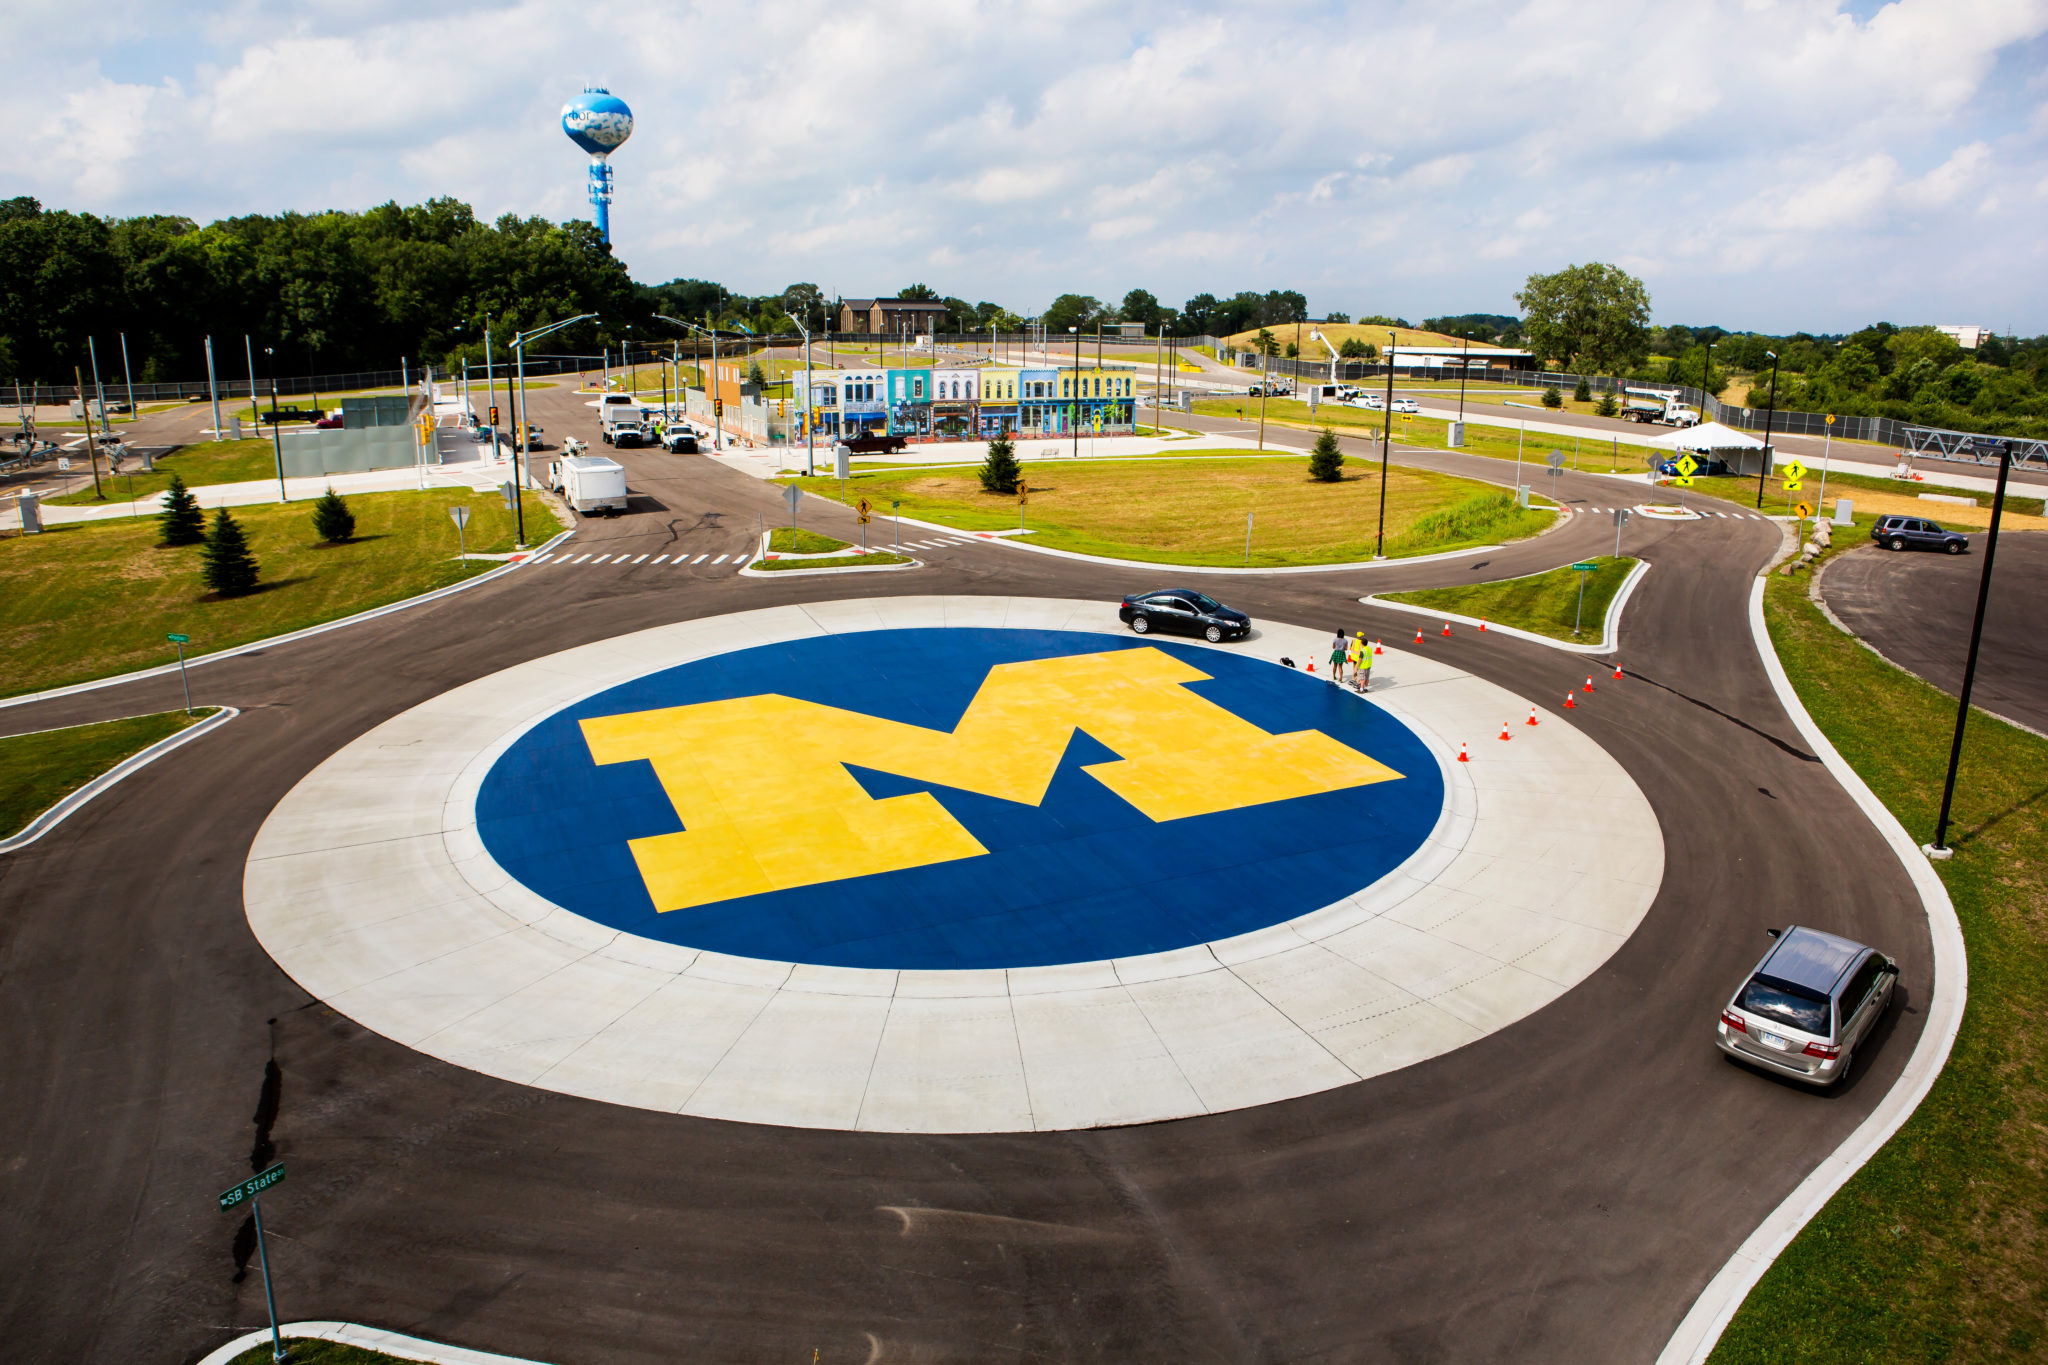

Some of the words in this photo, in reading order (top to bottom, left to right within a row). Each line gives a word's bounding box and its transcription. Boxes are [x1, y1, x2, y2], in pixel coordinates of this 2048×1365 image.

[578, 646, 1407, 914] M
[227, 1189, 243, 1205] SB
[247, 1172, 277, 1194] State
